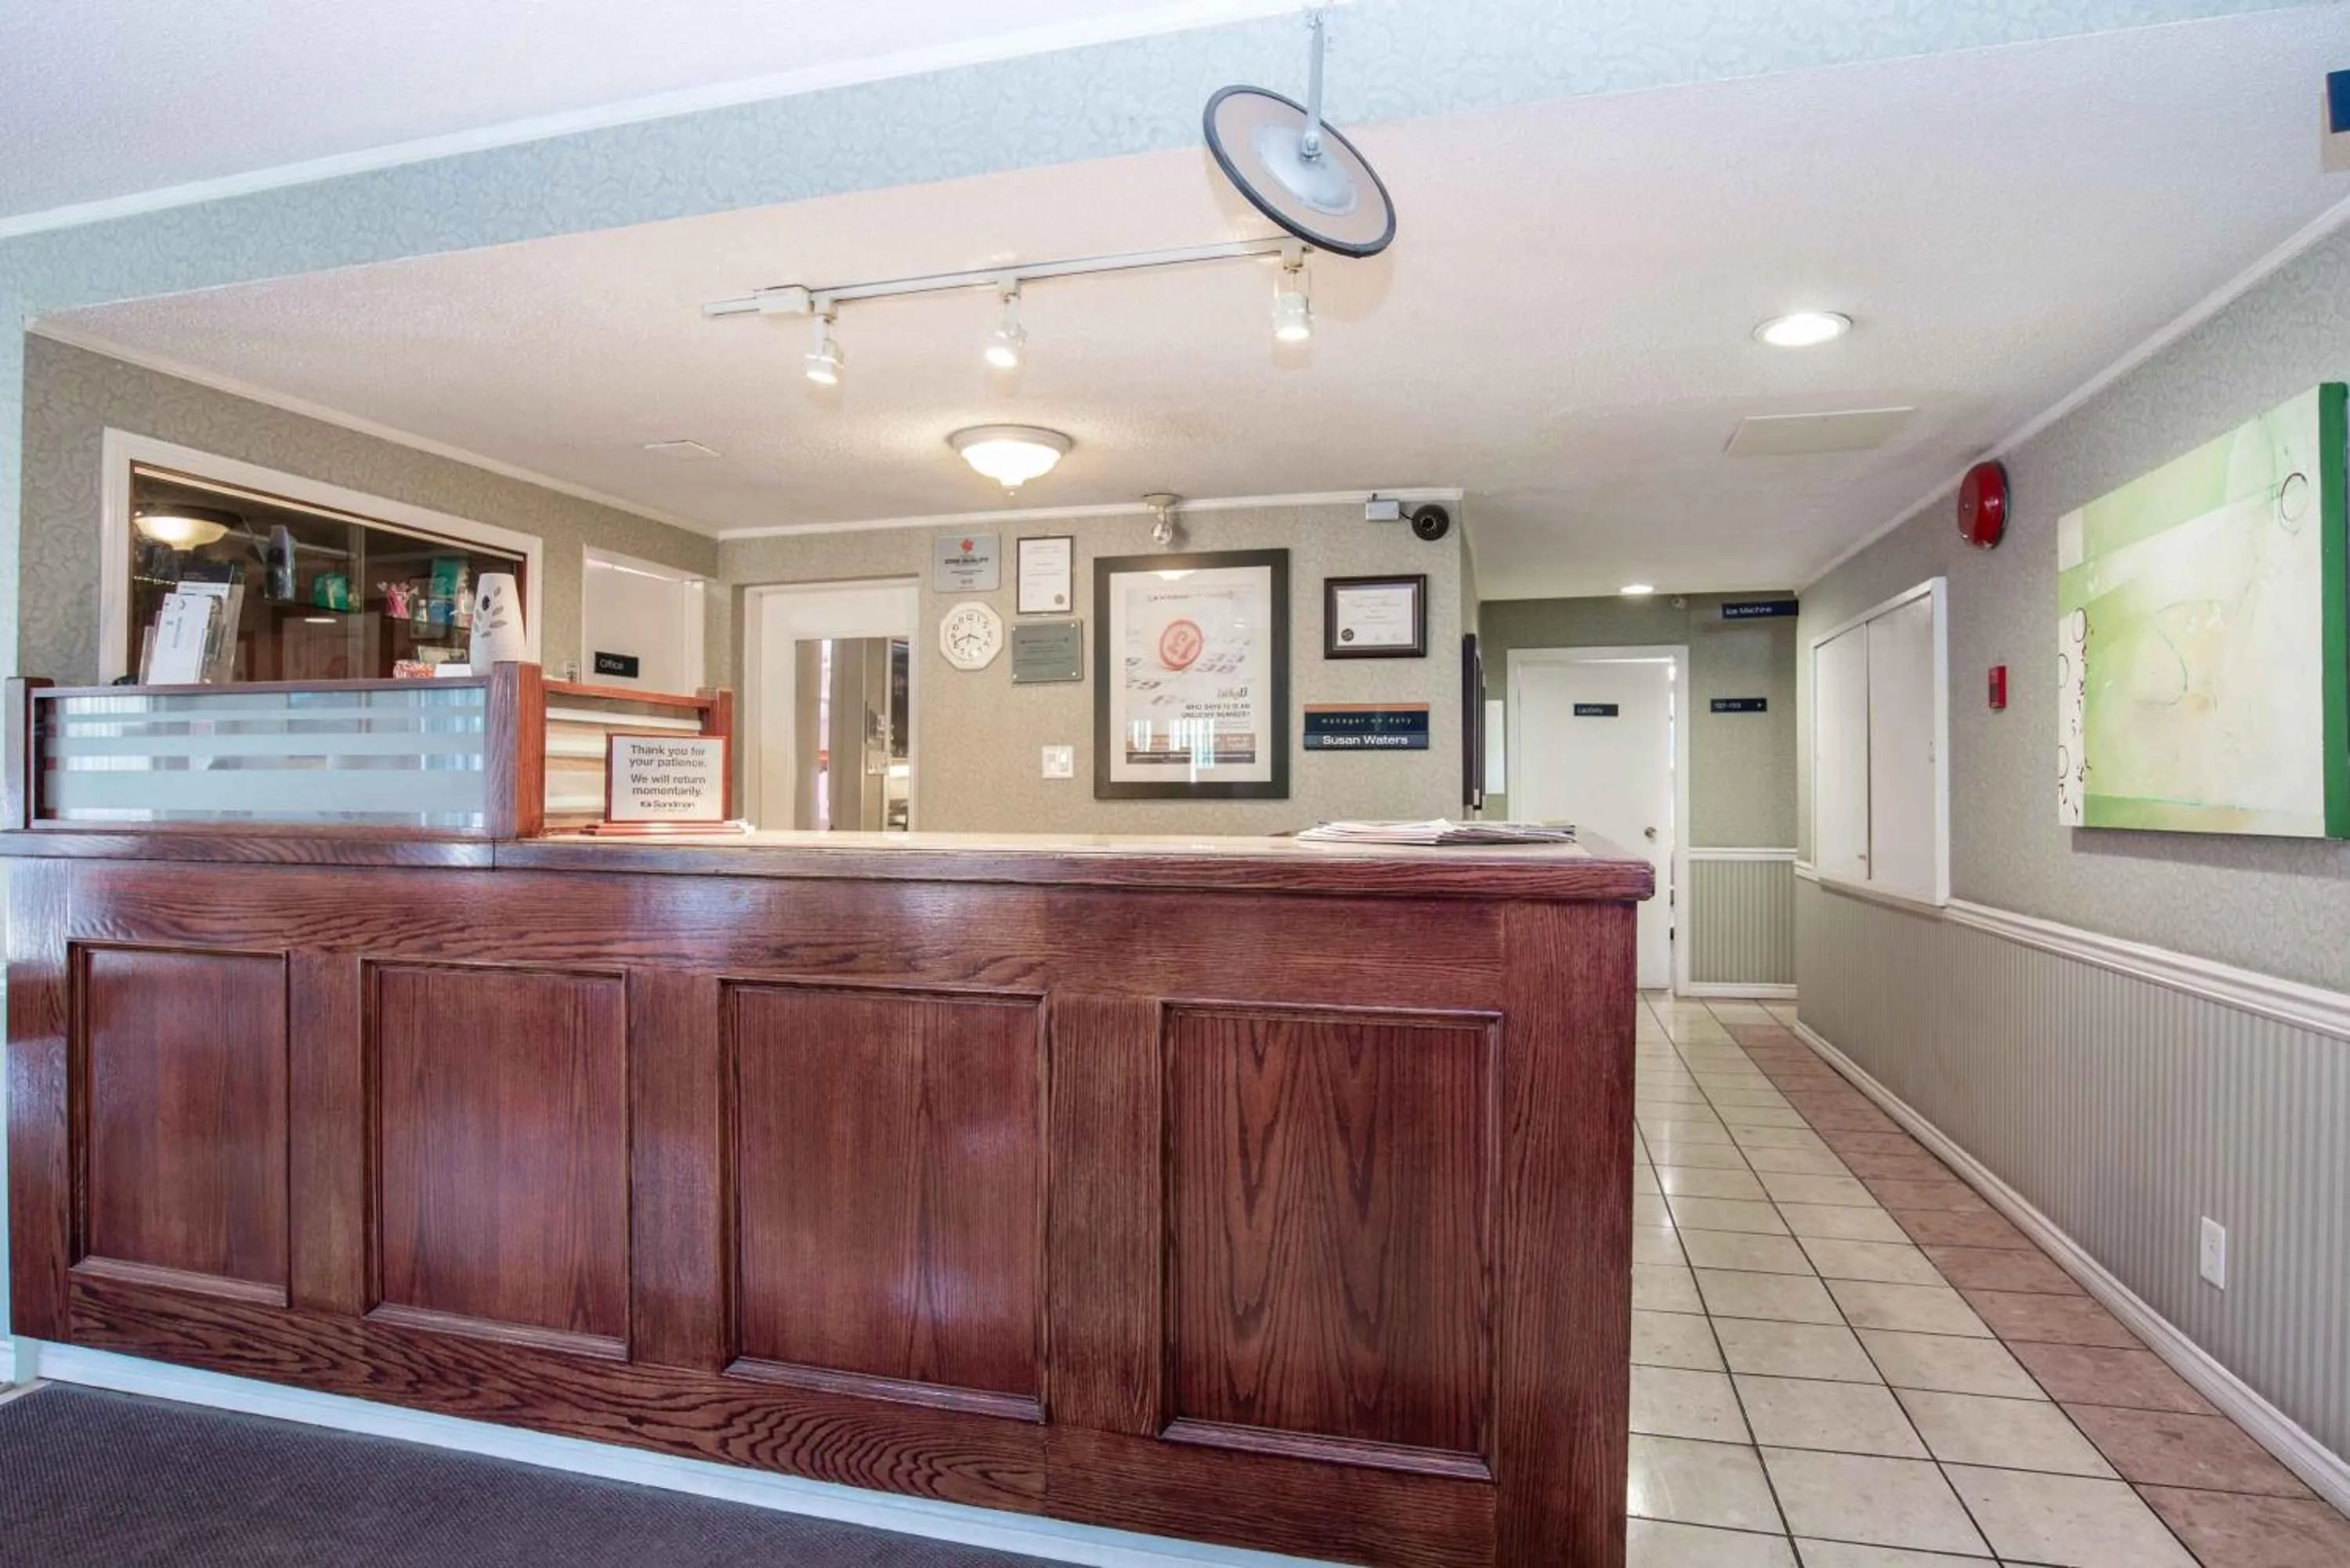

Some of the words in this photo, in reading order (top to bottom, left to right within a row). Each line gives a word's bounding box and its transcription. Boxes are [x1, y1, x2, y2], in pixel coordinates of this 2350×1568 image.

[599, 659, 624, 670] Office
[1322, 735, 1361, 745] Susan
[1364, 735, 1408, 745] Waters
[631, 745, 665, 755] Thank
[667, 748, 689, 757] you
[691, 746, 706, 756] for
[629, 758, 655, 768] your
[657, 757, 707, 768] patience.
[631, 774, 649, 784] We
[651, 774, 670, 784] will
[673, 775, 706, 784] return
[632, 786, 703, 797] momentarily.
